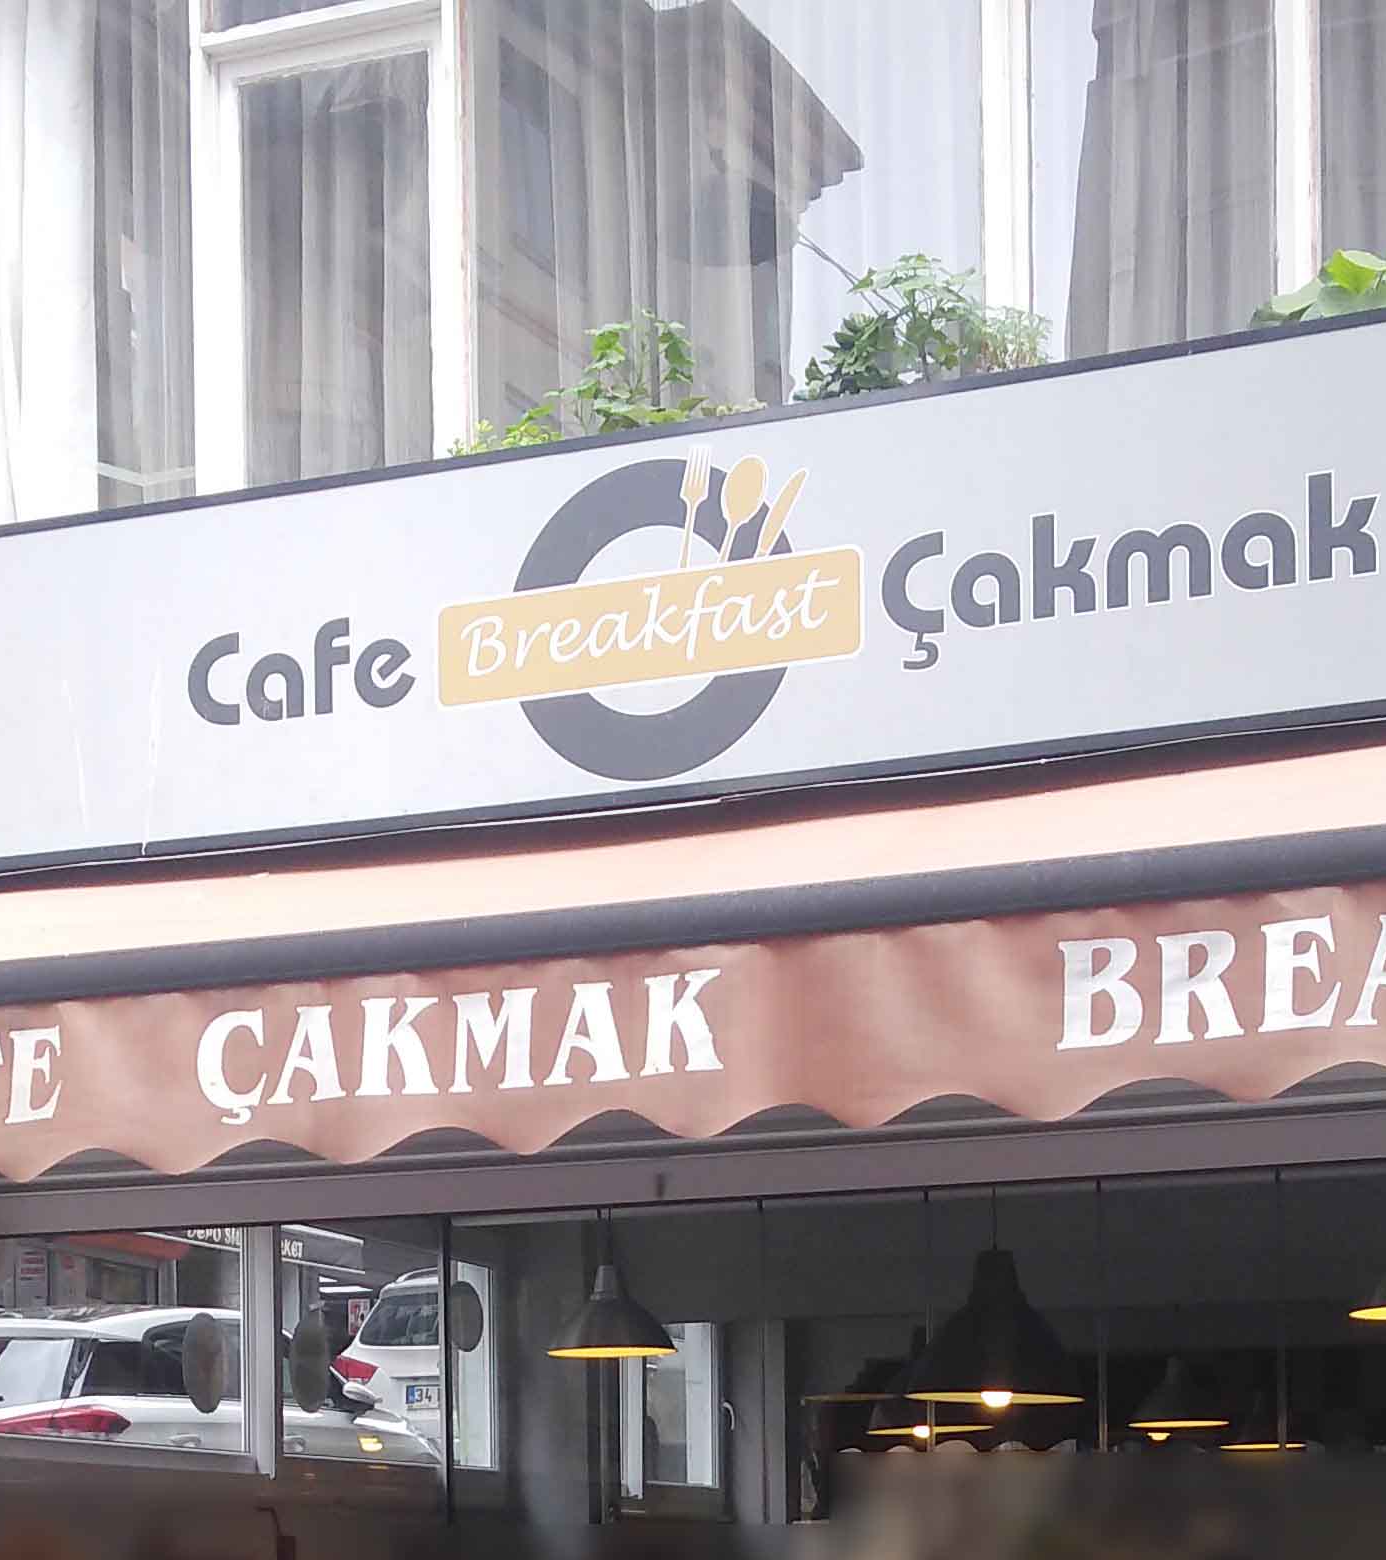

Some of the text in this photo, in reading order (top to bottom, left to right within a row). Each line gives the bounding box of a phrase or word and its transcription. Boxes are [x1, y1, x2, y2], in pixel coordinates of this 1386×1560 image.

[187, 470, 1381, 726] Cafe Breakfast Çakmak
[195, 967, 724, 1126] ÇAKMAK
